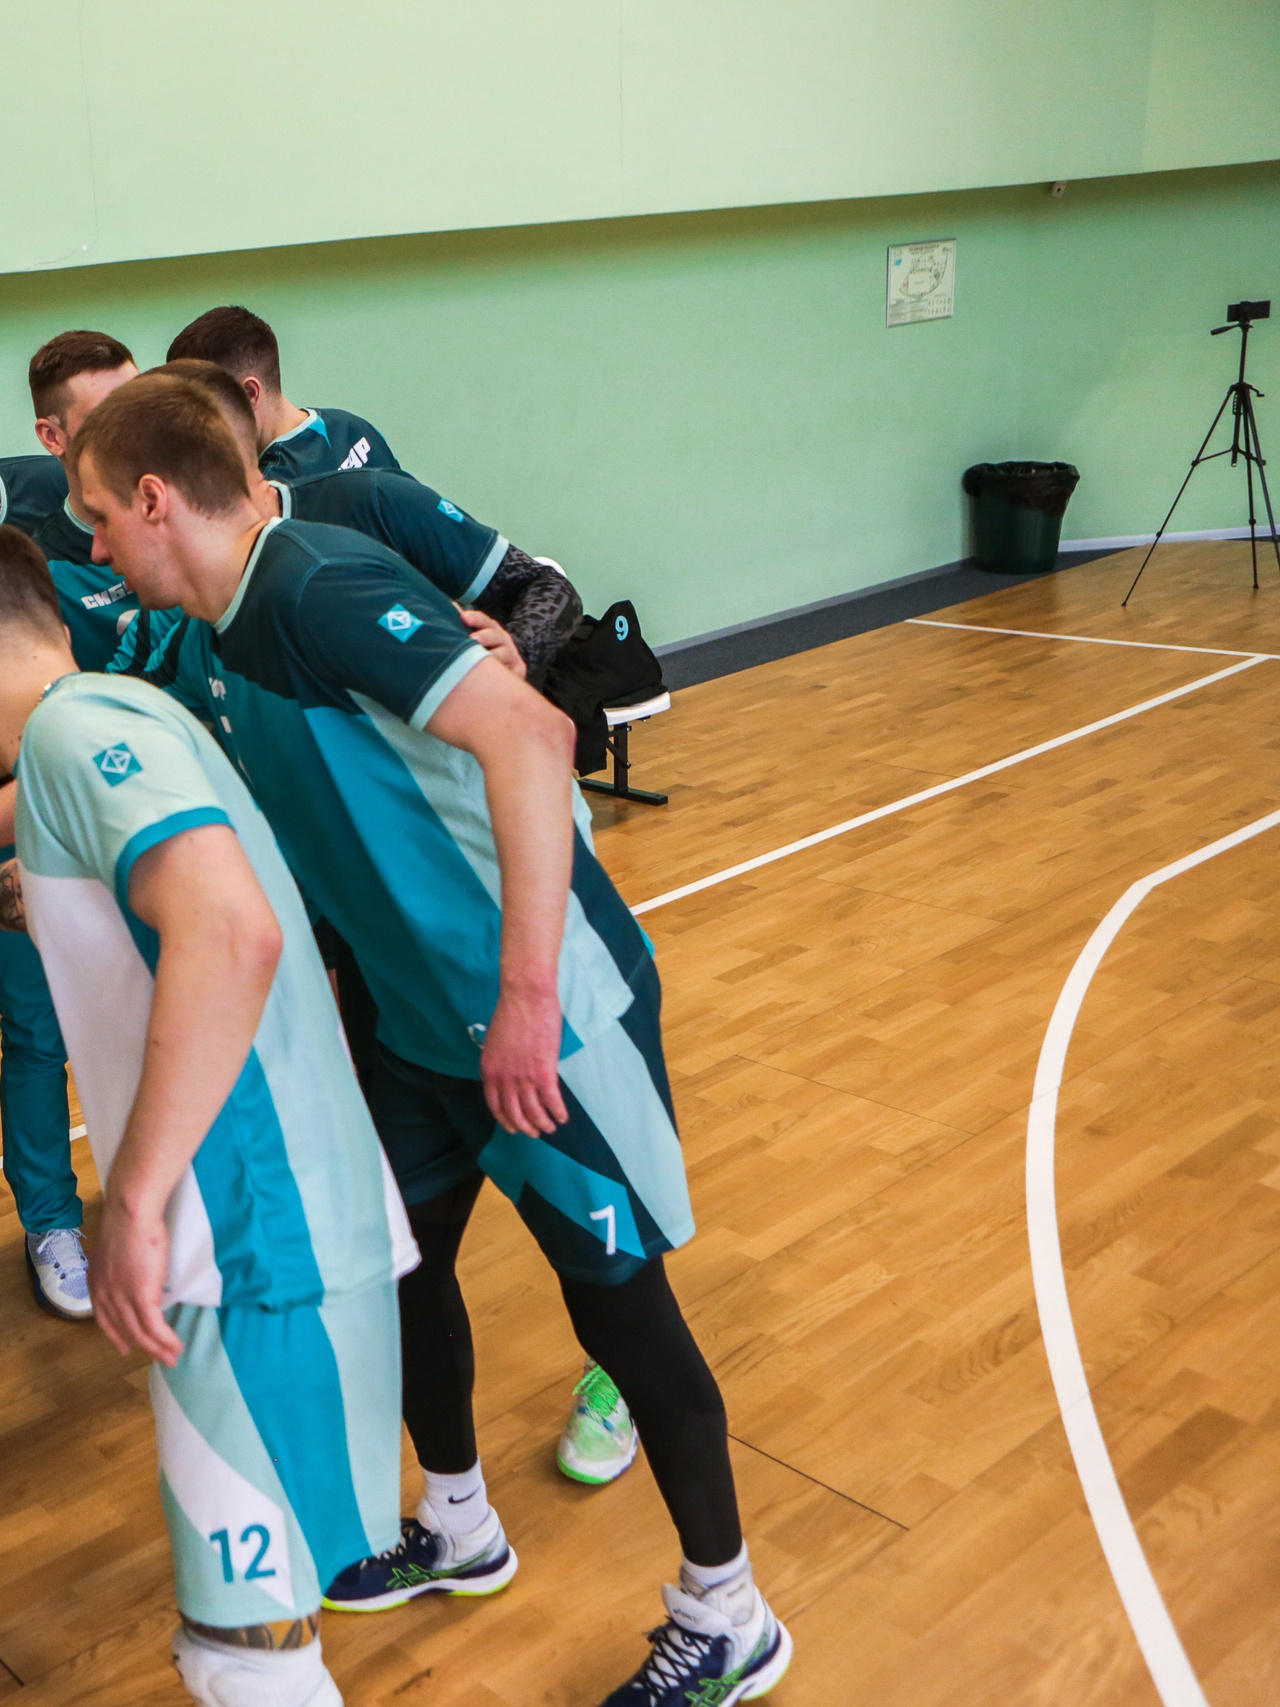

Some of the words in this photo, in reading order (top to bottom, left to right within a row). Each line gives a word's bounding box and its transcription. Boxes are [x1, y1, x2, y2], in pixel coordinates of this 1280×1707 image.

[81, 580, 134, 610] СИБ
[614, 615, 629, 641] 9
[209, 1524, 276, 1583] 12
